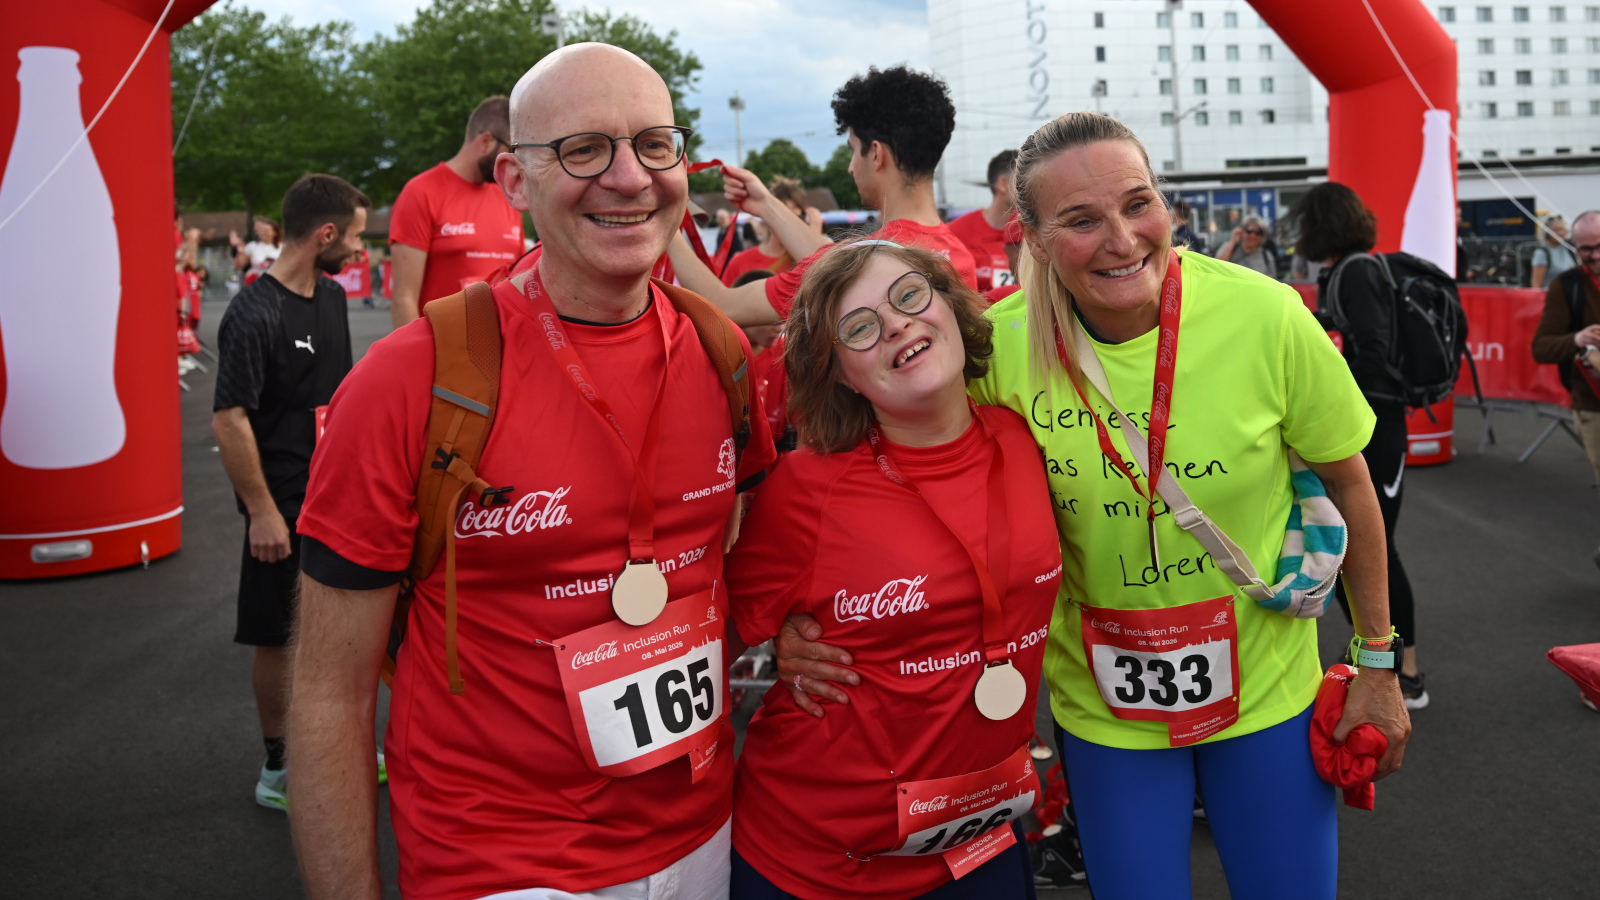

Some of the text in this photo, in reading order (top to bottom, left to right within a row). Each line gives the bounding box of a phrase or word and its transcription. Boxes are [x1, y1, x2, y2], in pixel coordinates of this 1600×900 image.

[1165, 277, 1179, 316] Coca-Cola
[538, 312, 567, 352] Coca-Cola
[1159, 328, 1175, 370] Coca-Cola
[1461, 342, 1504, 361] un
[566, 364, 599, 401] Coca-Cola
[1032, 390, 1176, 432] Geniess
[1154, 382, 1169, 422] Coca-Cola
[1043, 453, 1078, 477] as
[682, 487, 711, 502] GRAND
[711, 483, 726, 494] PRIX
[1049, 491, 1079, 515] ür
[454, 485, 573, 539] Coca-Cola
[545, 545, 708, 600] Inclusi un 2026
[1035, 569, 1058, 584] GRAND
[834, 573, 929, 623] Coca-Cola
[571, 639, 619, 670] Coca-Cola
[623, 631, 672, 652] Inclusion
[672, 622, 691, 636] Run
[1091, 618, 1121, 634] Coca-Cola
[1124, 627, 1167, 637] Inclusion
[1169, 625, 1189, 634] Run
[1161, 638, 1178, 646] 2026
[641, 641, 684, 661] 08. Mai 2026
[900, 650, 981, 675] Inclusion
[1114, 654, 1212, 707] 333
[613, 656, 714, 749] 165
[909, 781, 1008, 815] Coca-Cola Inclusion Run
[915, 808, 1013, 855] 166
[966, 834, 993, 853] GUTSCHEIN
